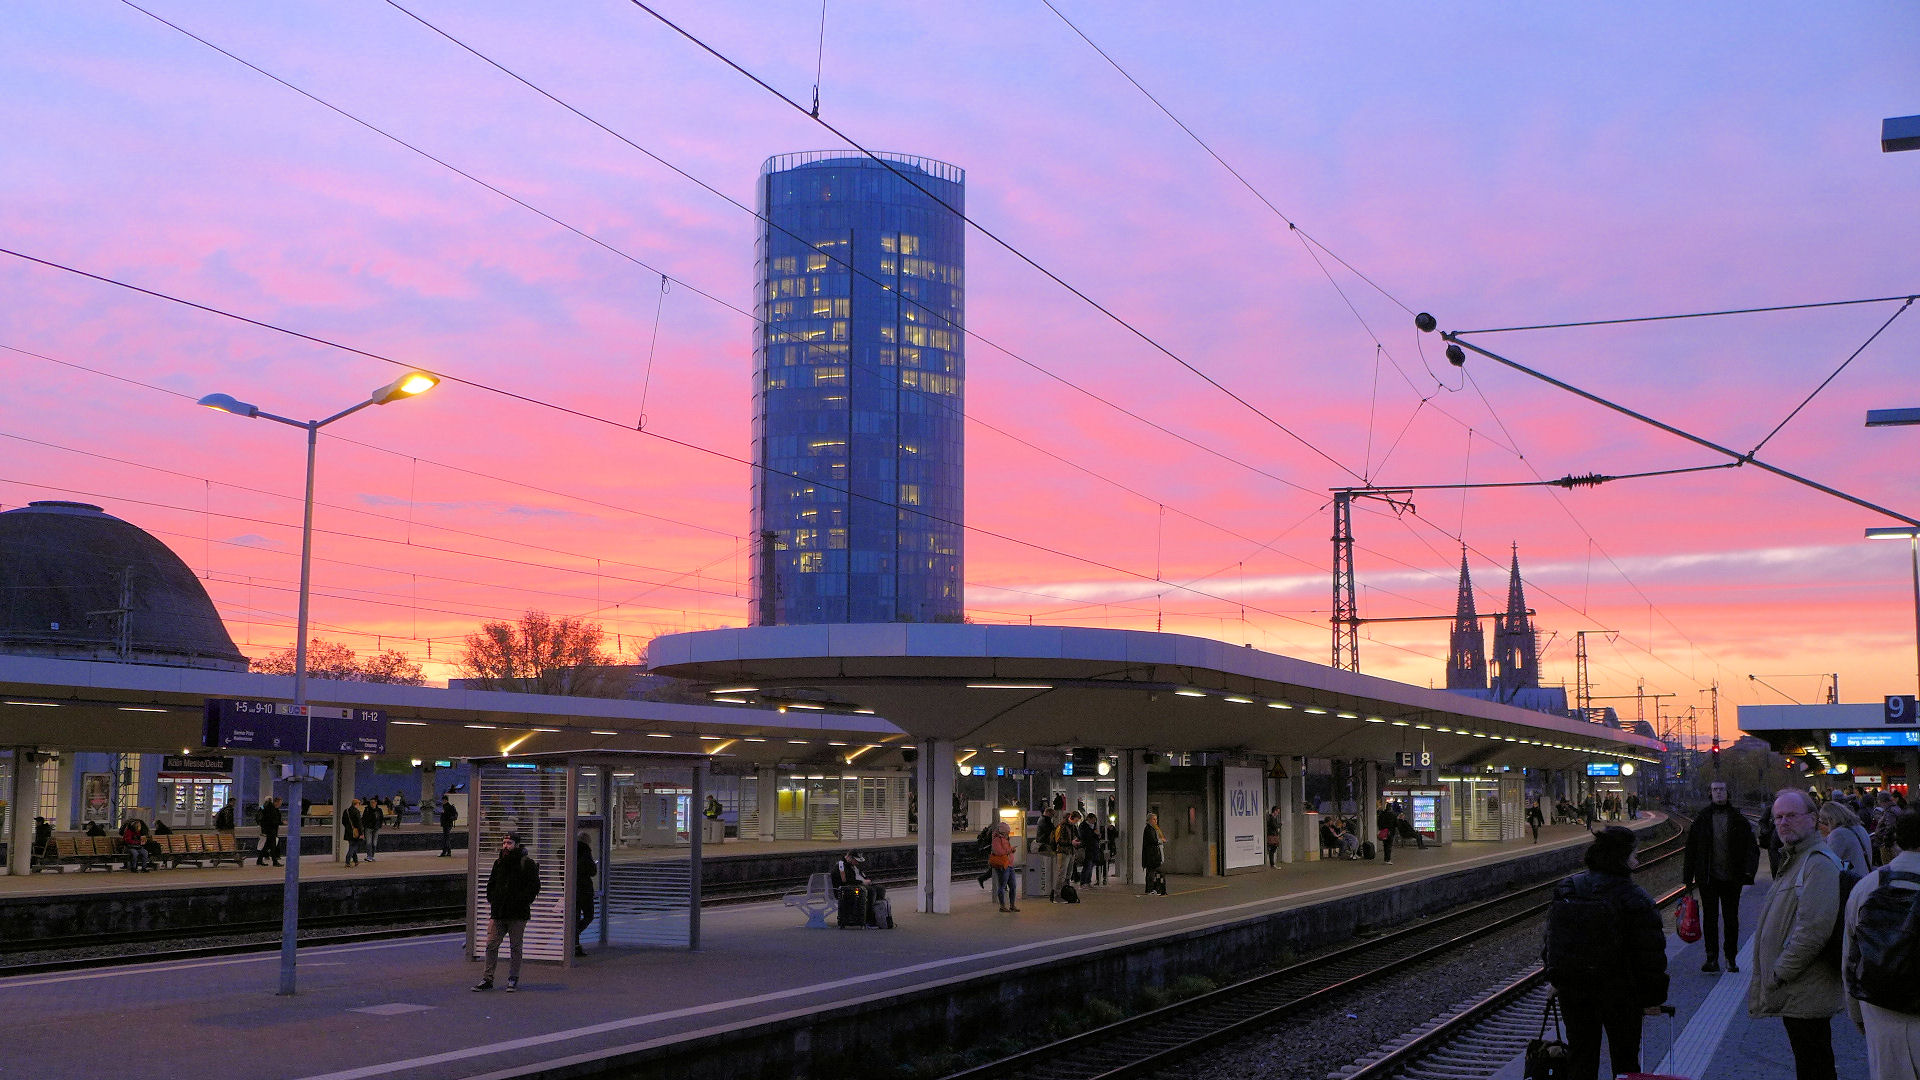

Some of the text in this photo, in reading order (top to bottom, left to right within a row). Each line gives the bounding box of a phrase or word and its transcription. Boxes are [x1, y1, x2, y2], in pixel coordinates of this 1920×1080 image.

[235, 701, 248, 713] 1-5
[255, 702, 273, 714] 9-10
[1888, 696, 1904, 718] 9
[361, 711, 378, 722] 11-12
[1830, 733, 1838, 743] 9
[1402, 752, 1431, 766] E 8
